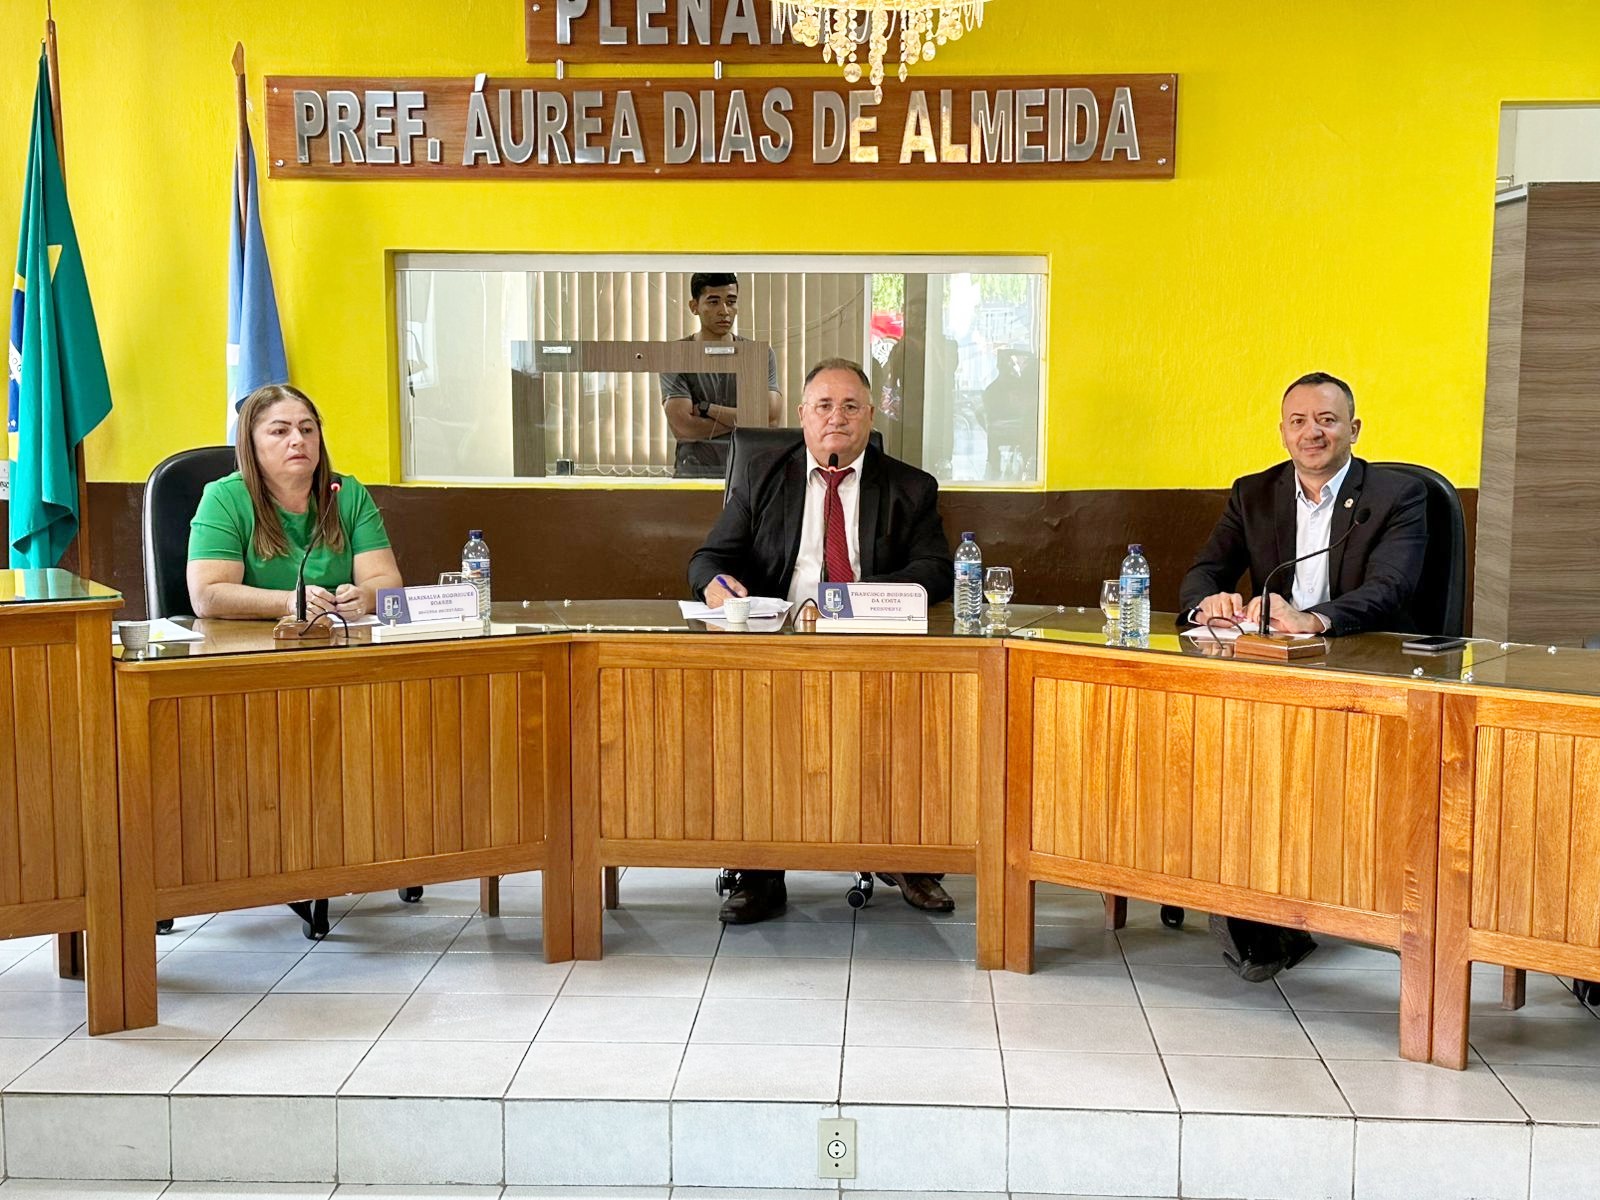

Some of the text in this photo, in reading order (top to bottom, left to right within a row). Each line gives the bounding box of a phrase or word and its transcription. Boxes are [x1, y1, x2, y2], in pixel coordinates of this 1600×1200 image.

[293, 73, 1141, 165] PREF. ÁUREA DIAS DE ALMEIDA
